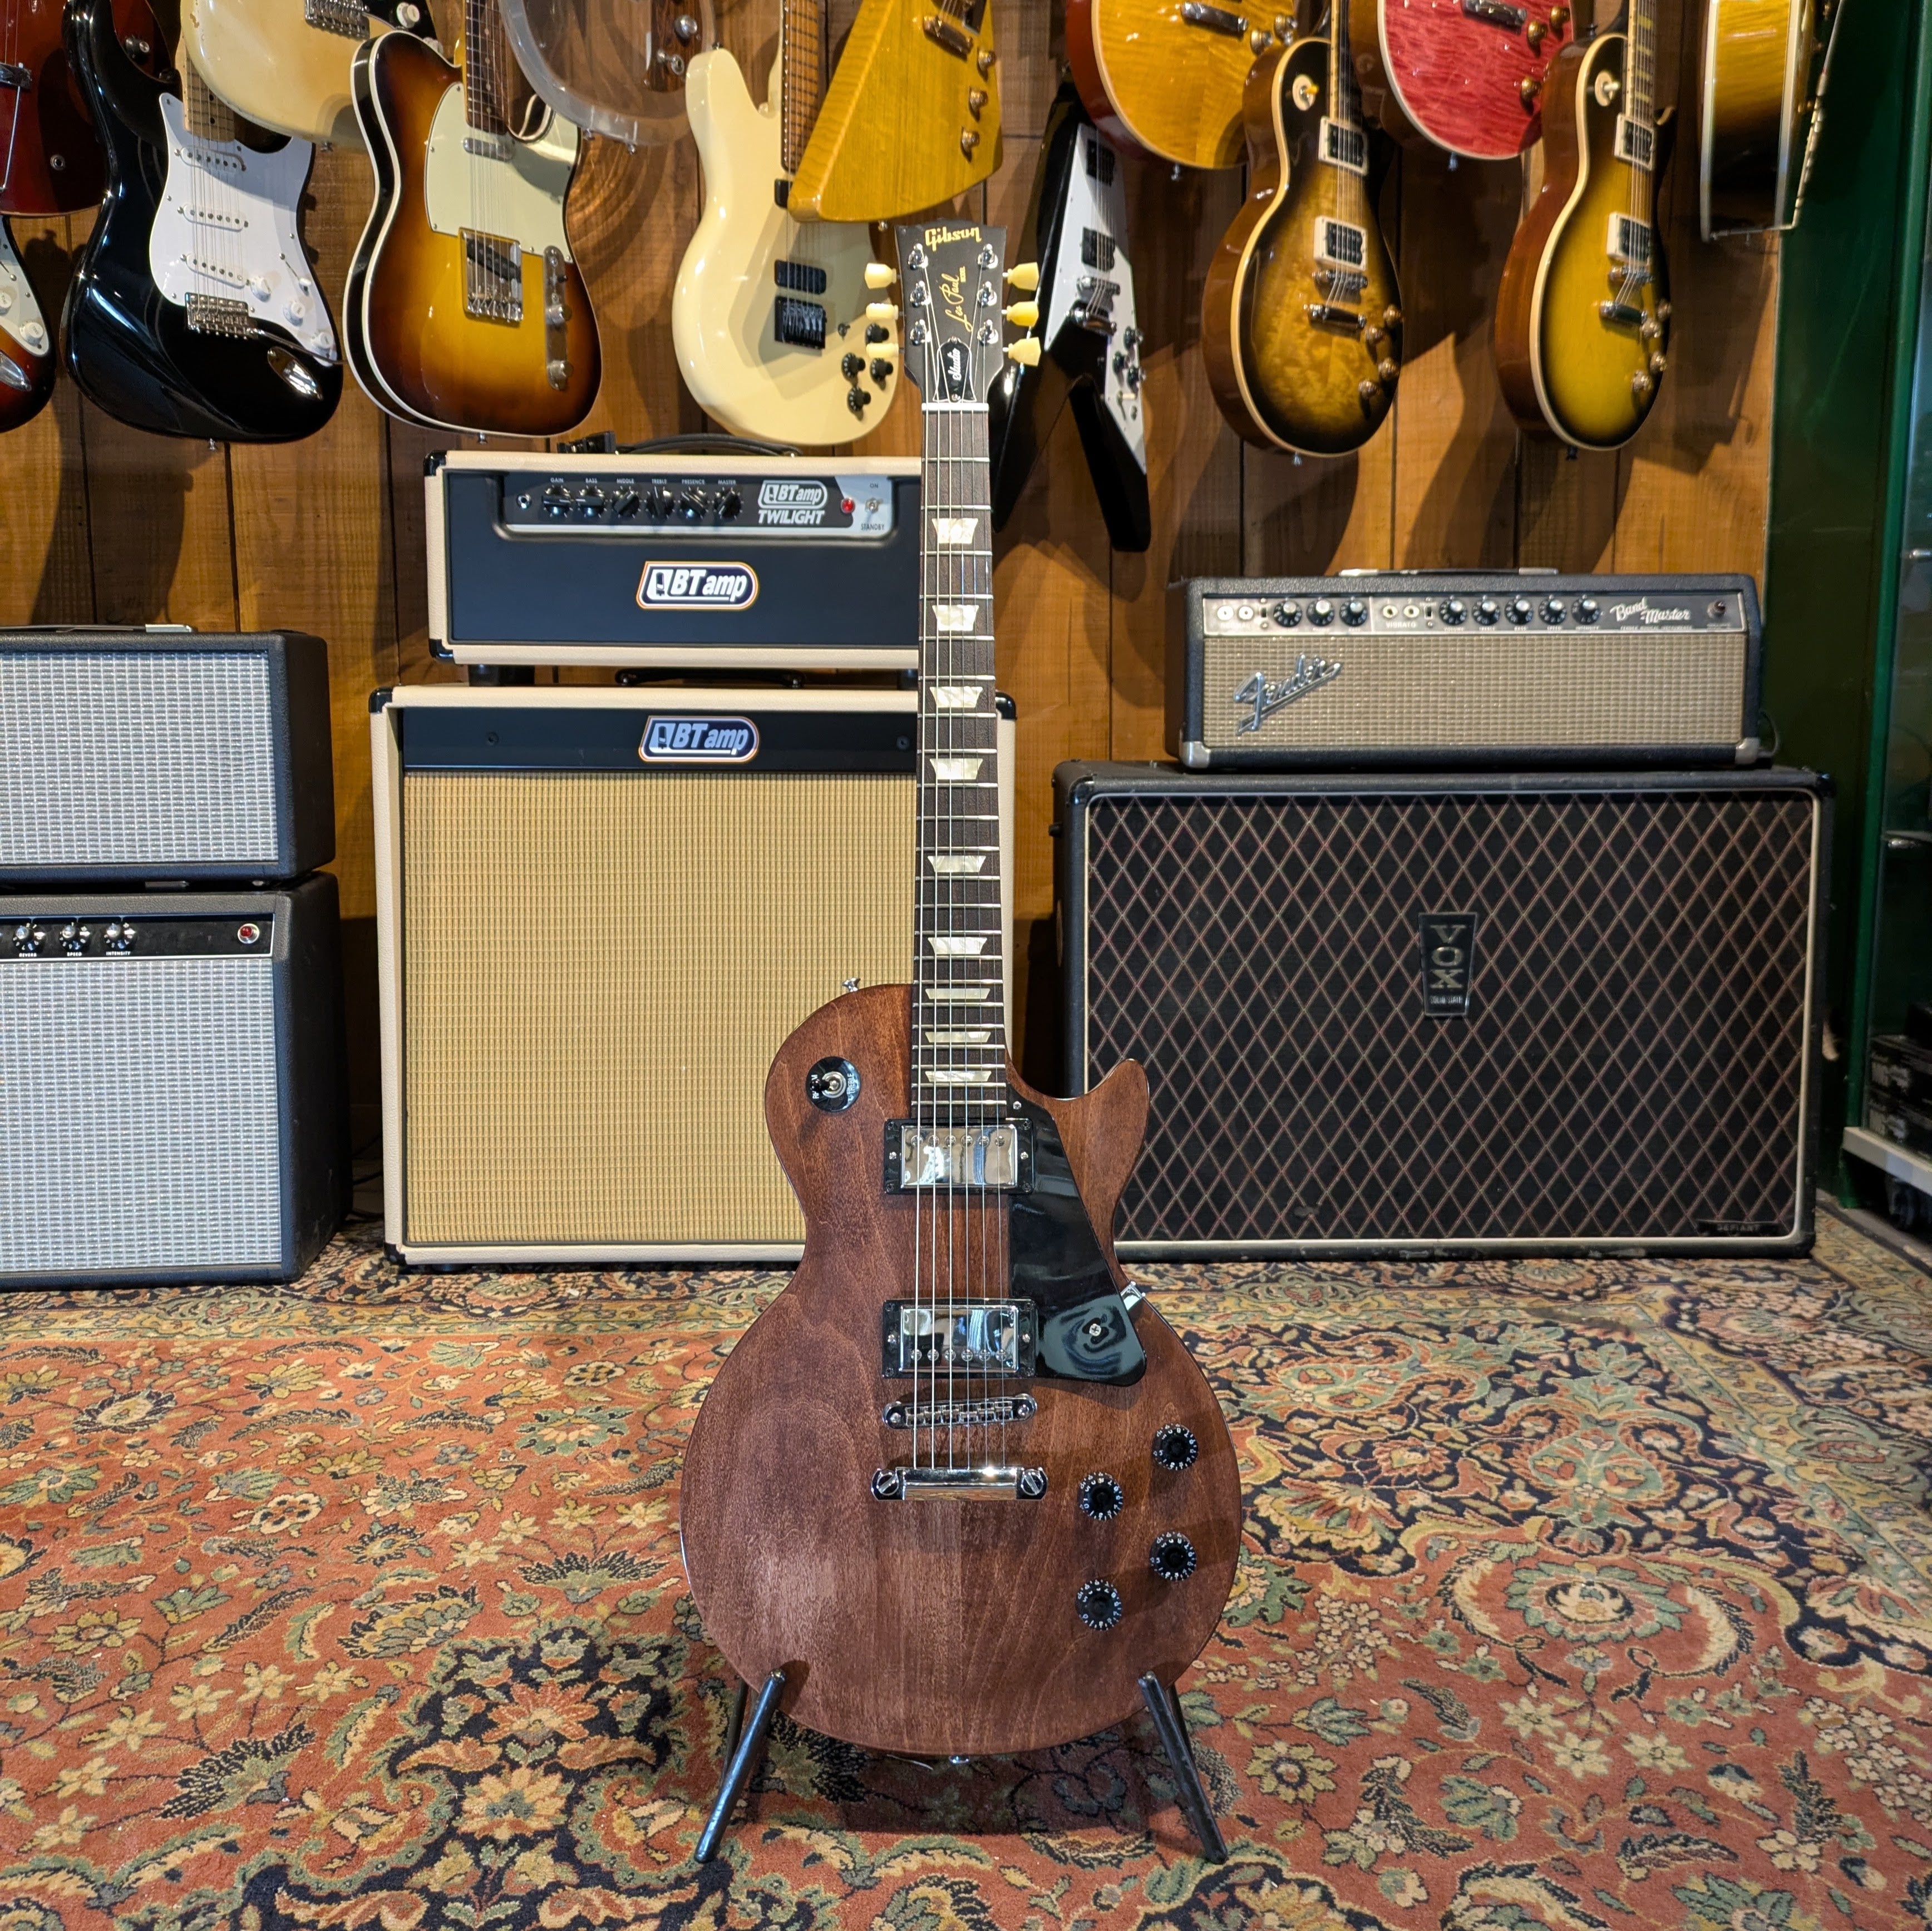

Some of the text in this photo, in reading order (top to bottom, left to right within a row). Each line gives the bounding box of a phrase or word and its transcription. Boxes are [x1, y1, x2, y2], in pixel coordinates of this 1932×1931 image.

[925, 226, 982, 251] Gibson
[940, 273, 973, 332] Les Paul
[948, 348, 962, 381] Studio
[757, 510, 825, 524] TWILIGHT
[1610, 596, 1691, 624] Band Master
[1429, 925, 1466, 989] VOX
[847, 1073, 856, 1094] TREBLE
